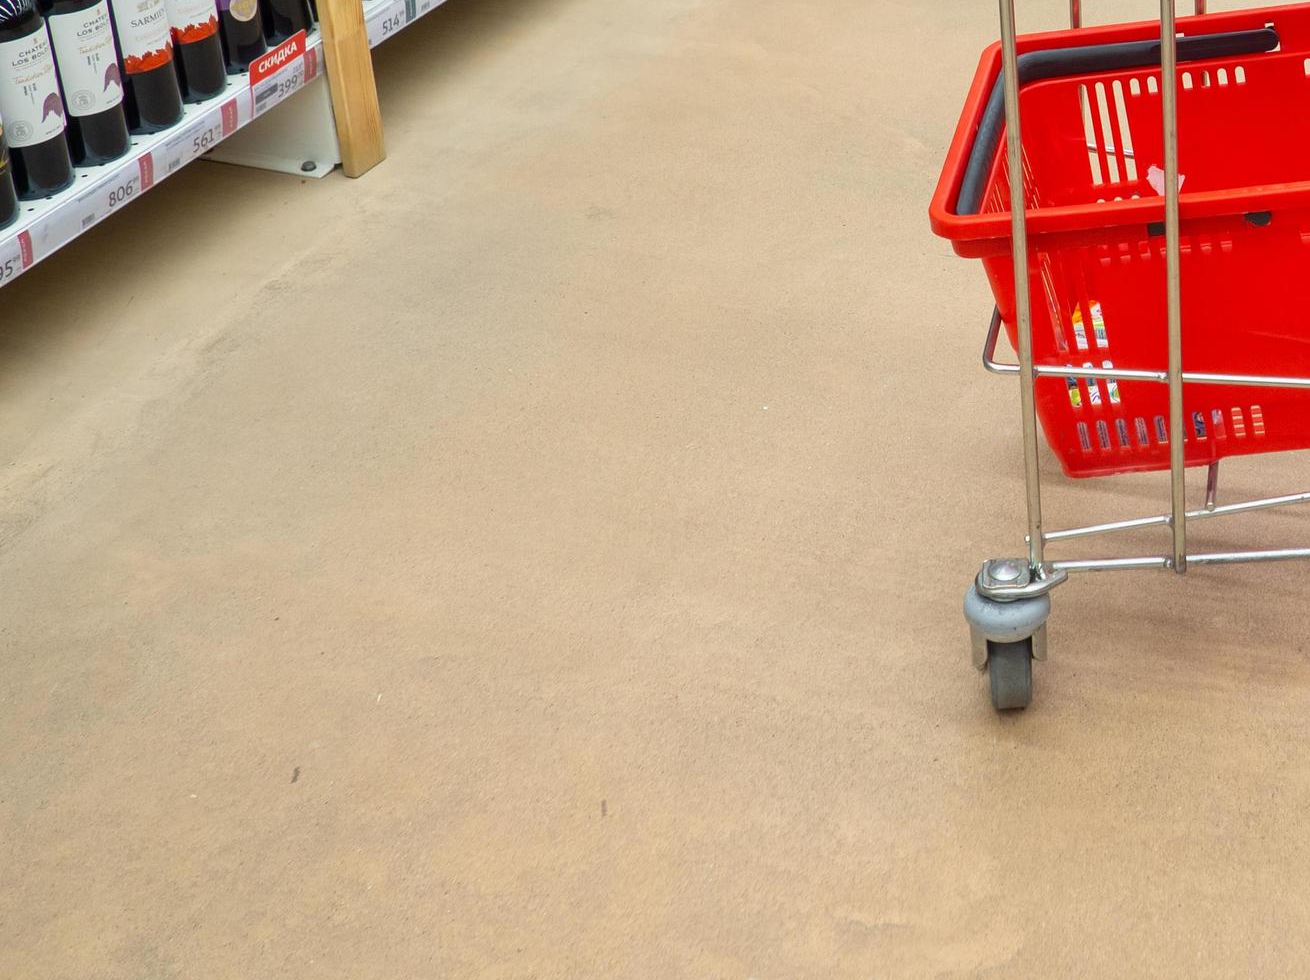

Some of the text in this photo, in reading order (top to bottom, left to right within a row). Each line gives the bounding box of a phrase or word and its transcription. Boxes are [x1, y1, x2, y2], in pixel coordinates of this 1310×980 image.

[382, 14, 400, 35] 514
[12, 57, 29, 67] LOS
[258, 42, 298, 74] СКИДКА
[277, 77, 298, 99] 399
[192, 127, 215, 153] 561
[108, 182, 133, 208] 806
